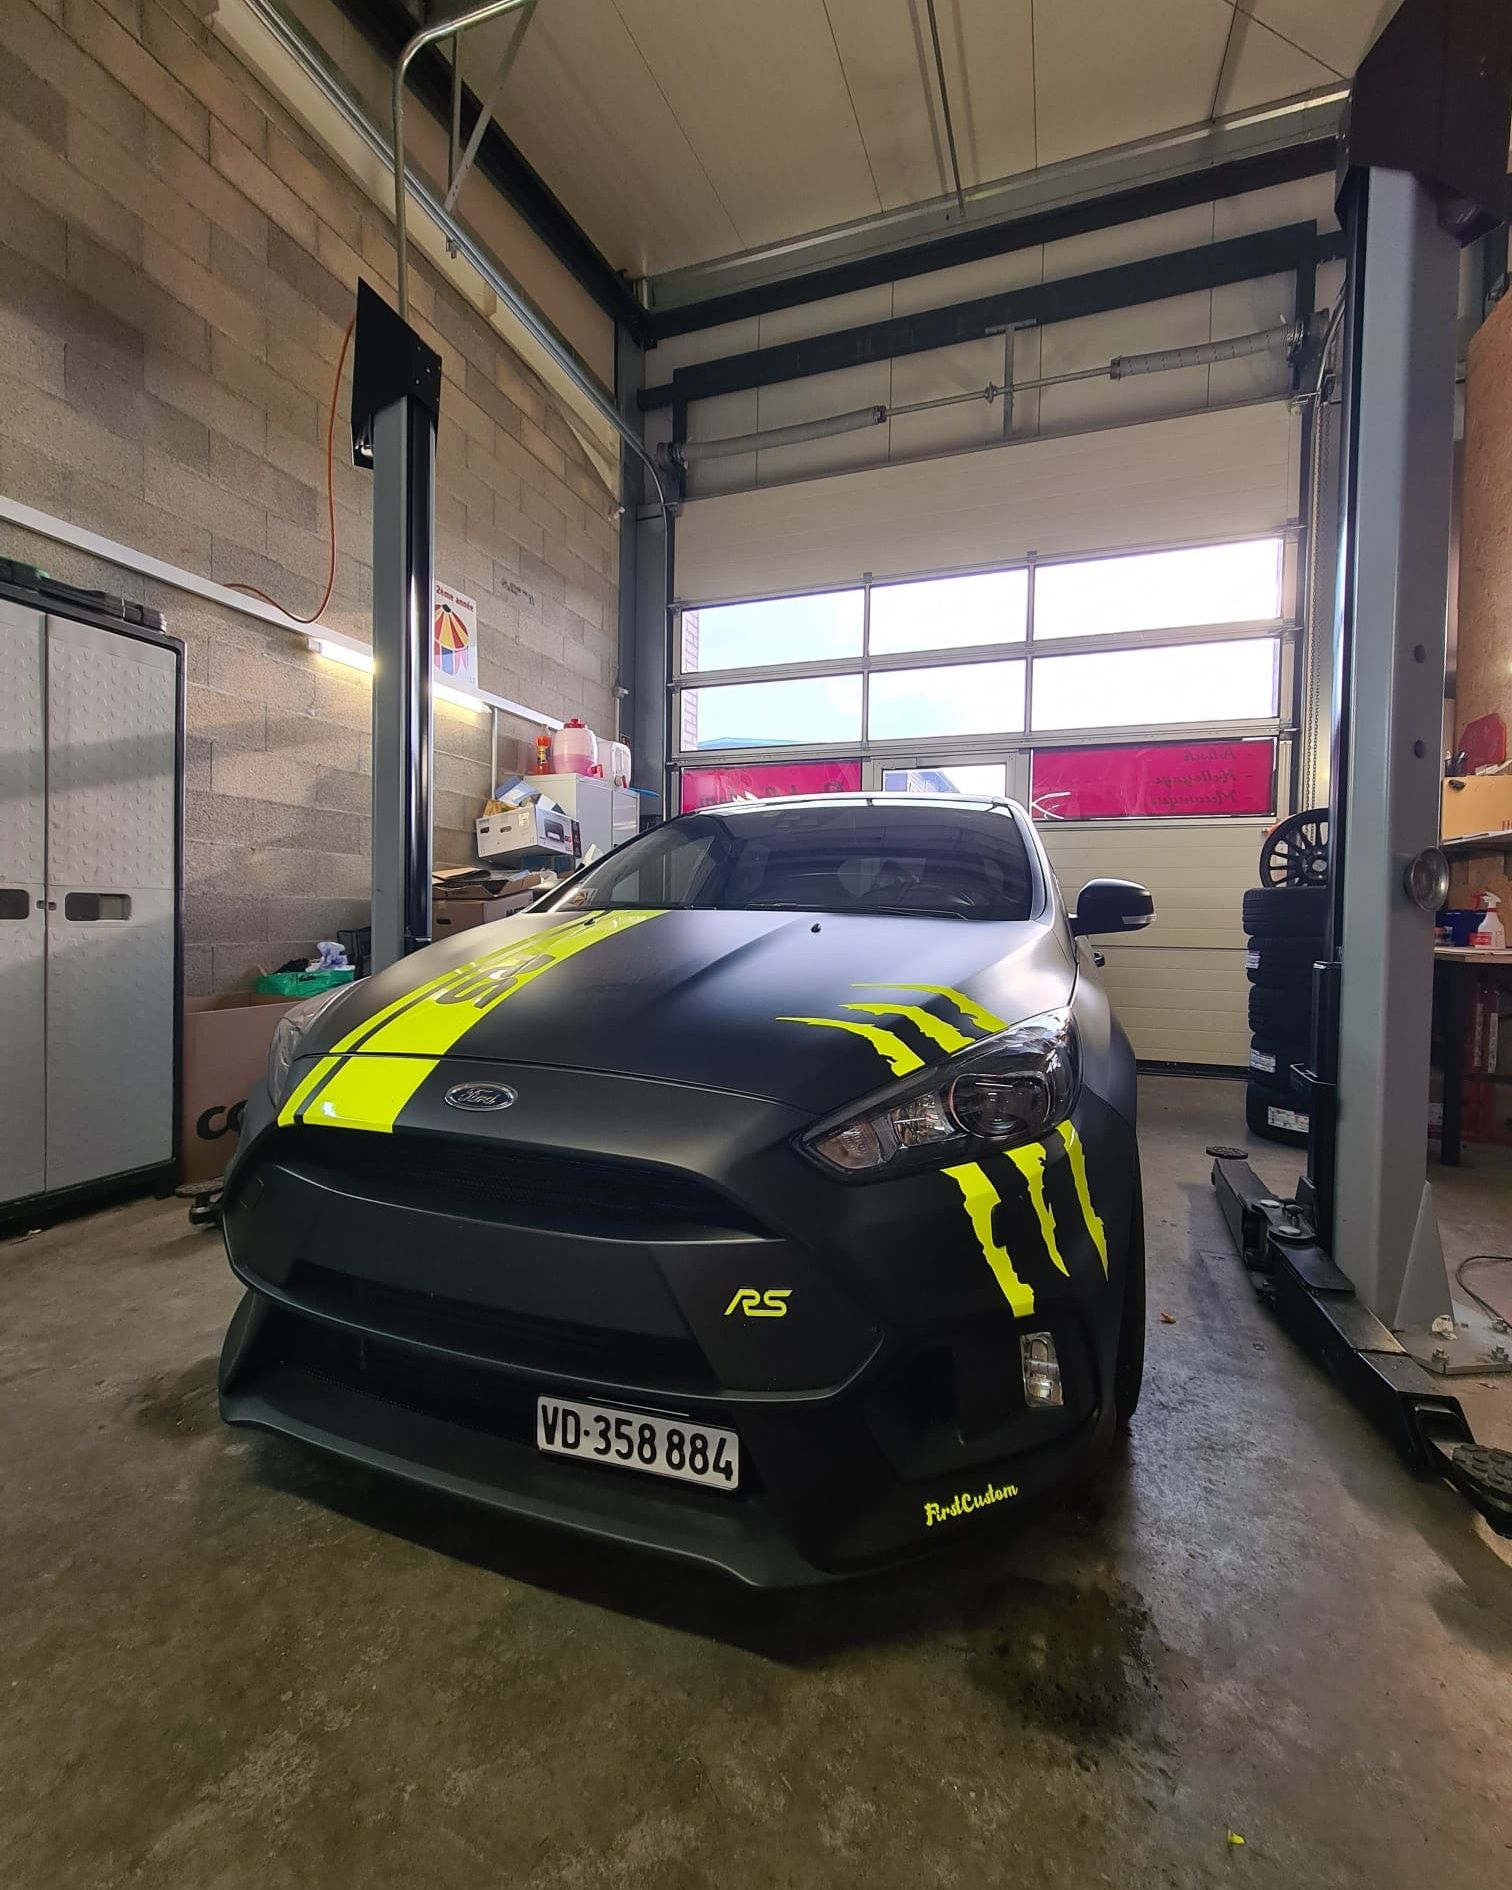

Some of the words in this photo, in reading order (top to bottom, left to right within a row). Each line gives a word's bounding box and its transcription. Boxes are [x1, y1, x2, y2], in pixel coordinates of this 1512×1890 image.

[457, 1087, 500, 1105] Ford
[723, 1288, 794, 1317] RS
[923, 1483, 1019, 1527] FirstCustom
